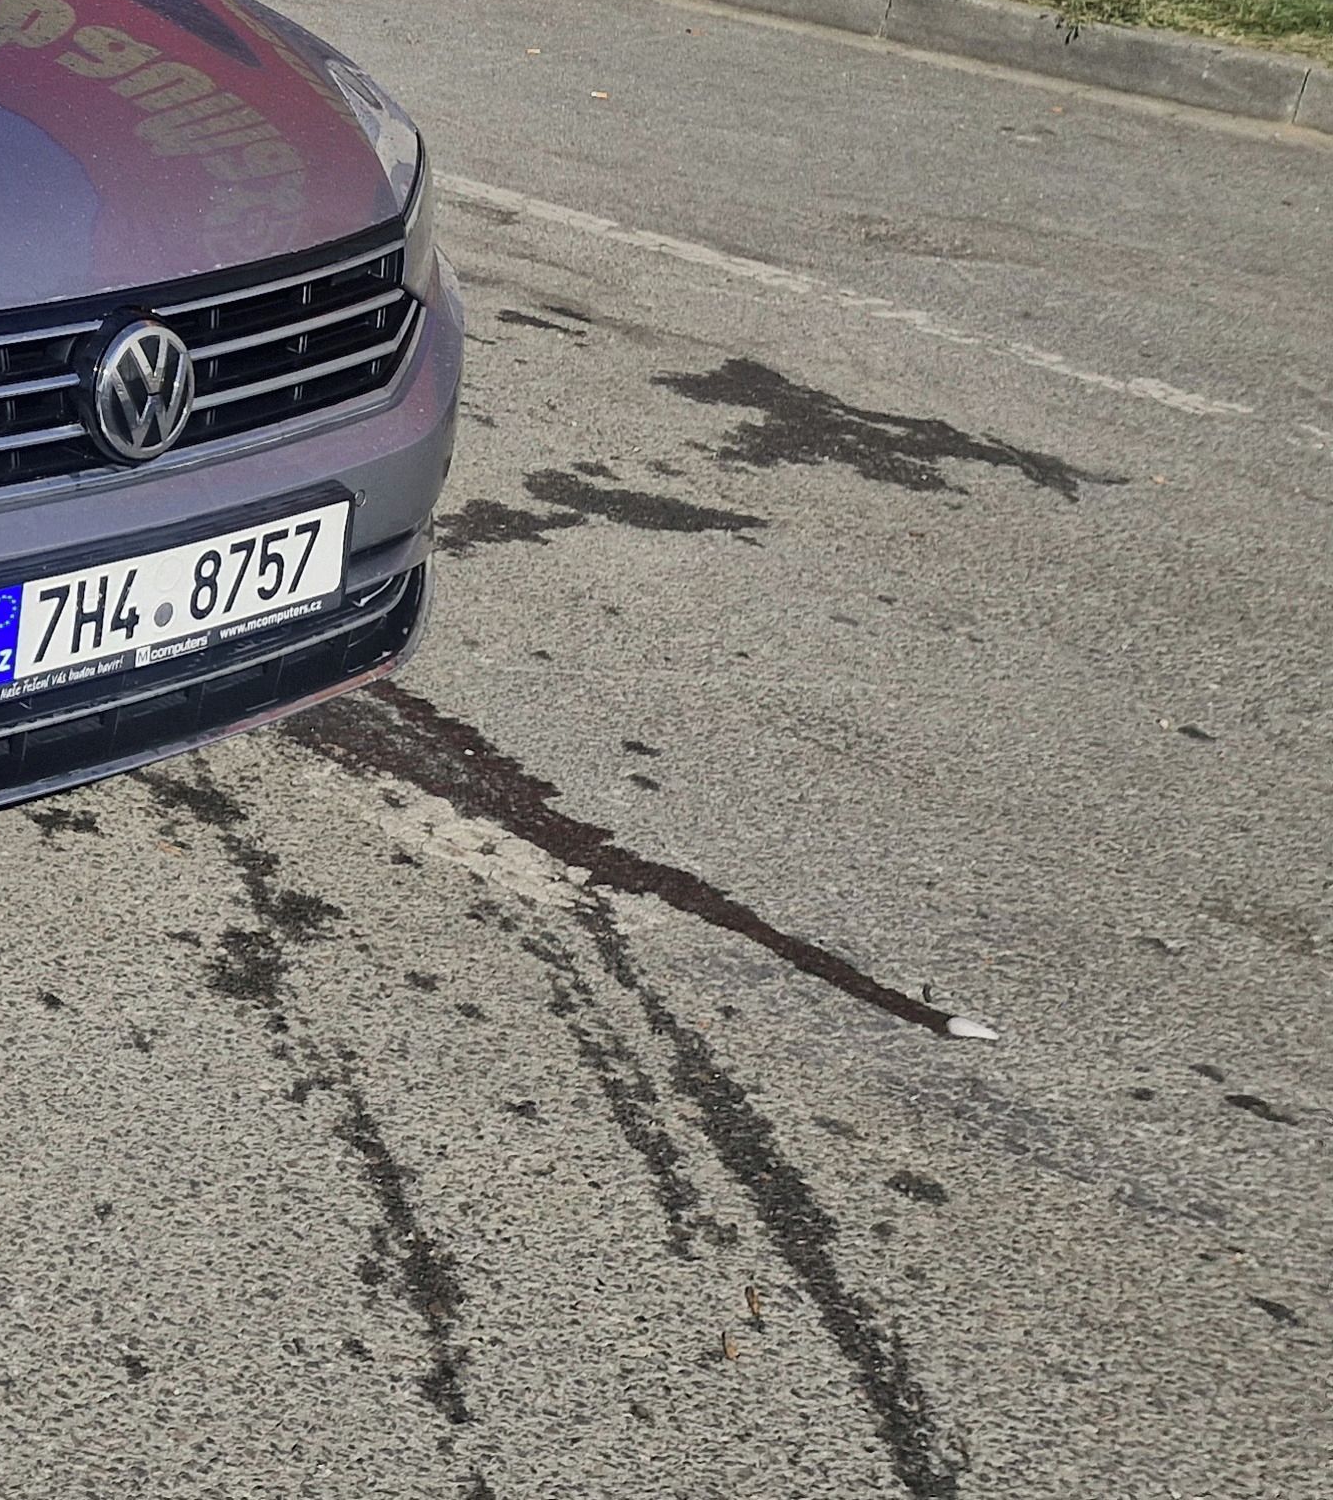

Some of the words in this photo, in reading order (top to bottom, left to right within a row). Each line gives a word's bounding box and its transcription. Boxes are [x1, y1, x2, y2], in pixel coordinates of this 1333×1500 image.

[33, 569, 140, 663] 7H4
[189, 519, 322, 620] 8757
[219, 599, 323, 640] www.mcomputers.cz
